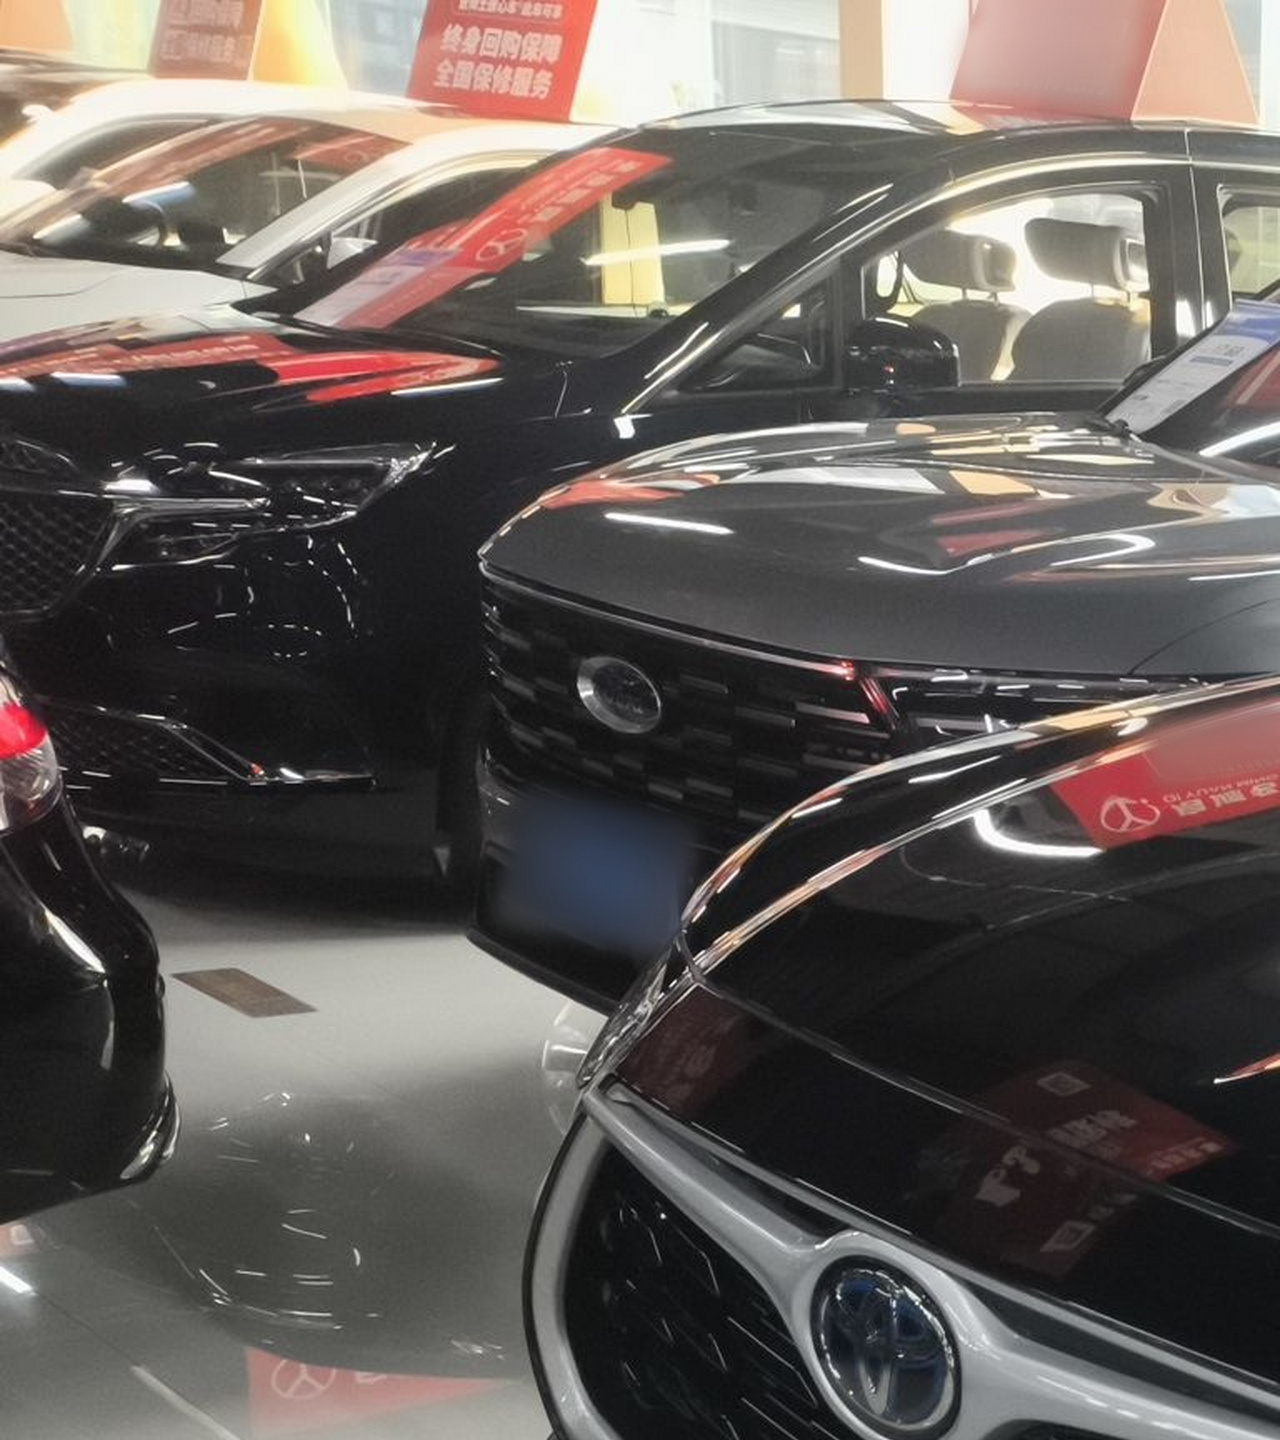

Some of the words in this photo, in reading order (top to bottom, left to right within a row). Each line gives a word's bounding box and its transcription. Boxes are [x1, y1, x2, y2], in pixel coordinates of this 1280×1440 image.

[441, 24, 563, 62] 终身回购保障
[433, 60, 552, 99] 全国保修服务
